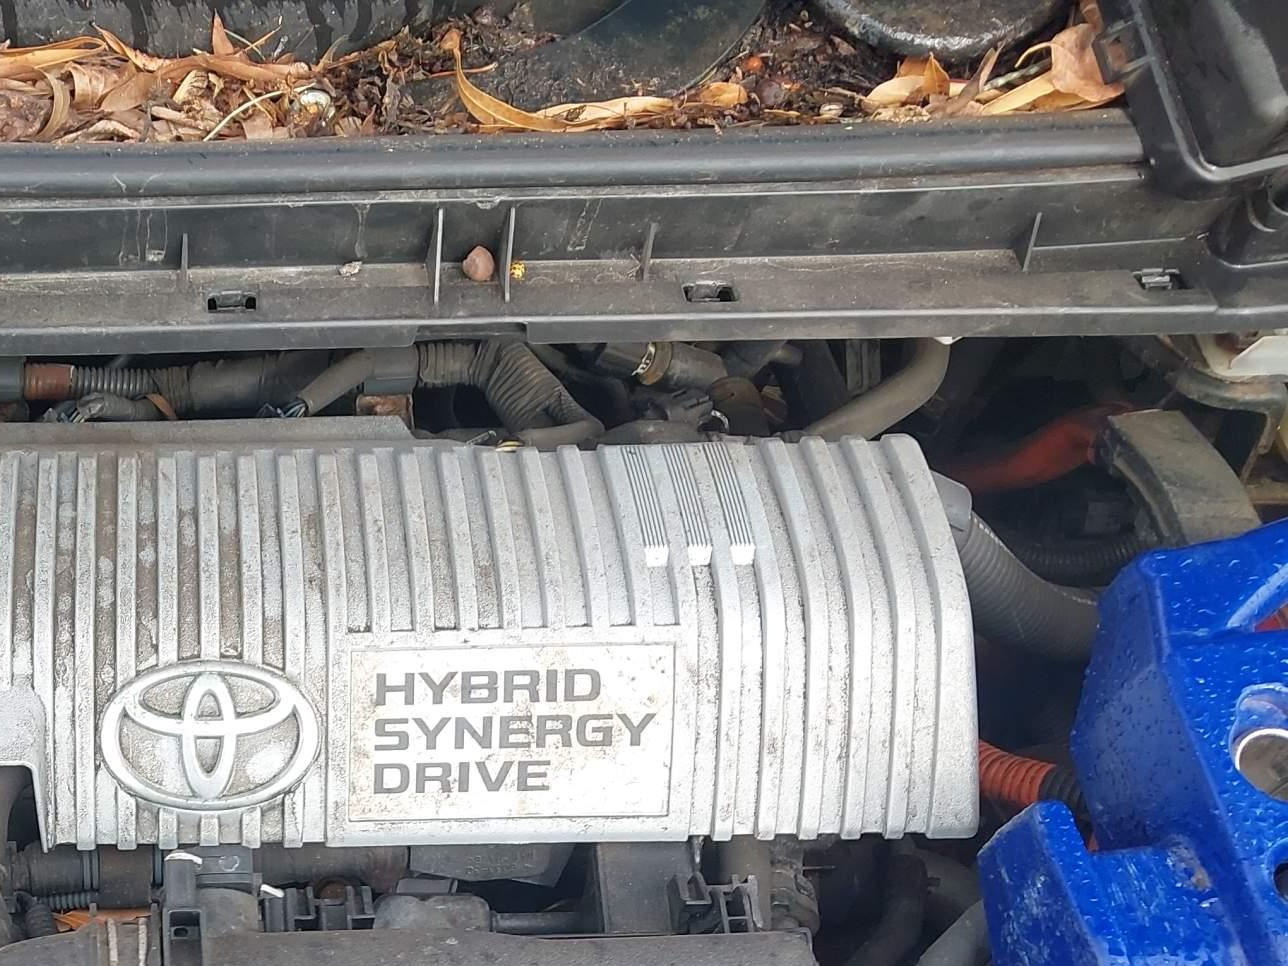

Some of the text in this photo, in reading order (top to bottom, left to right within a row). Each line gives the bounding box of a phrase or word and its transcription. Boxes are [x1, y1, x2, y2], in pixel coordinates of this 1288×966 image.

[375, 668, 602, 706] HYBRID
[374, 712, 657, 751] SYNERGY
[373, 760, 551, 794] DRIVE
